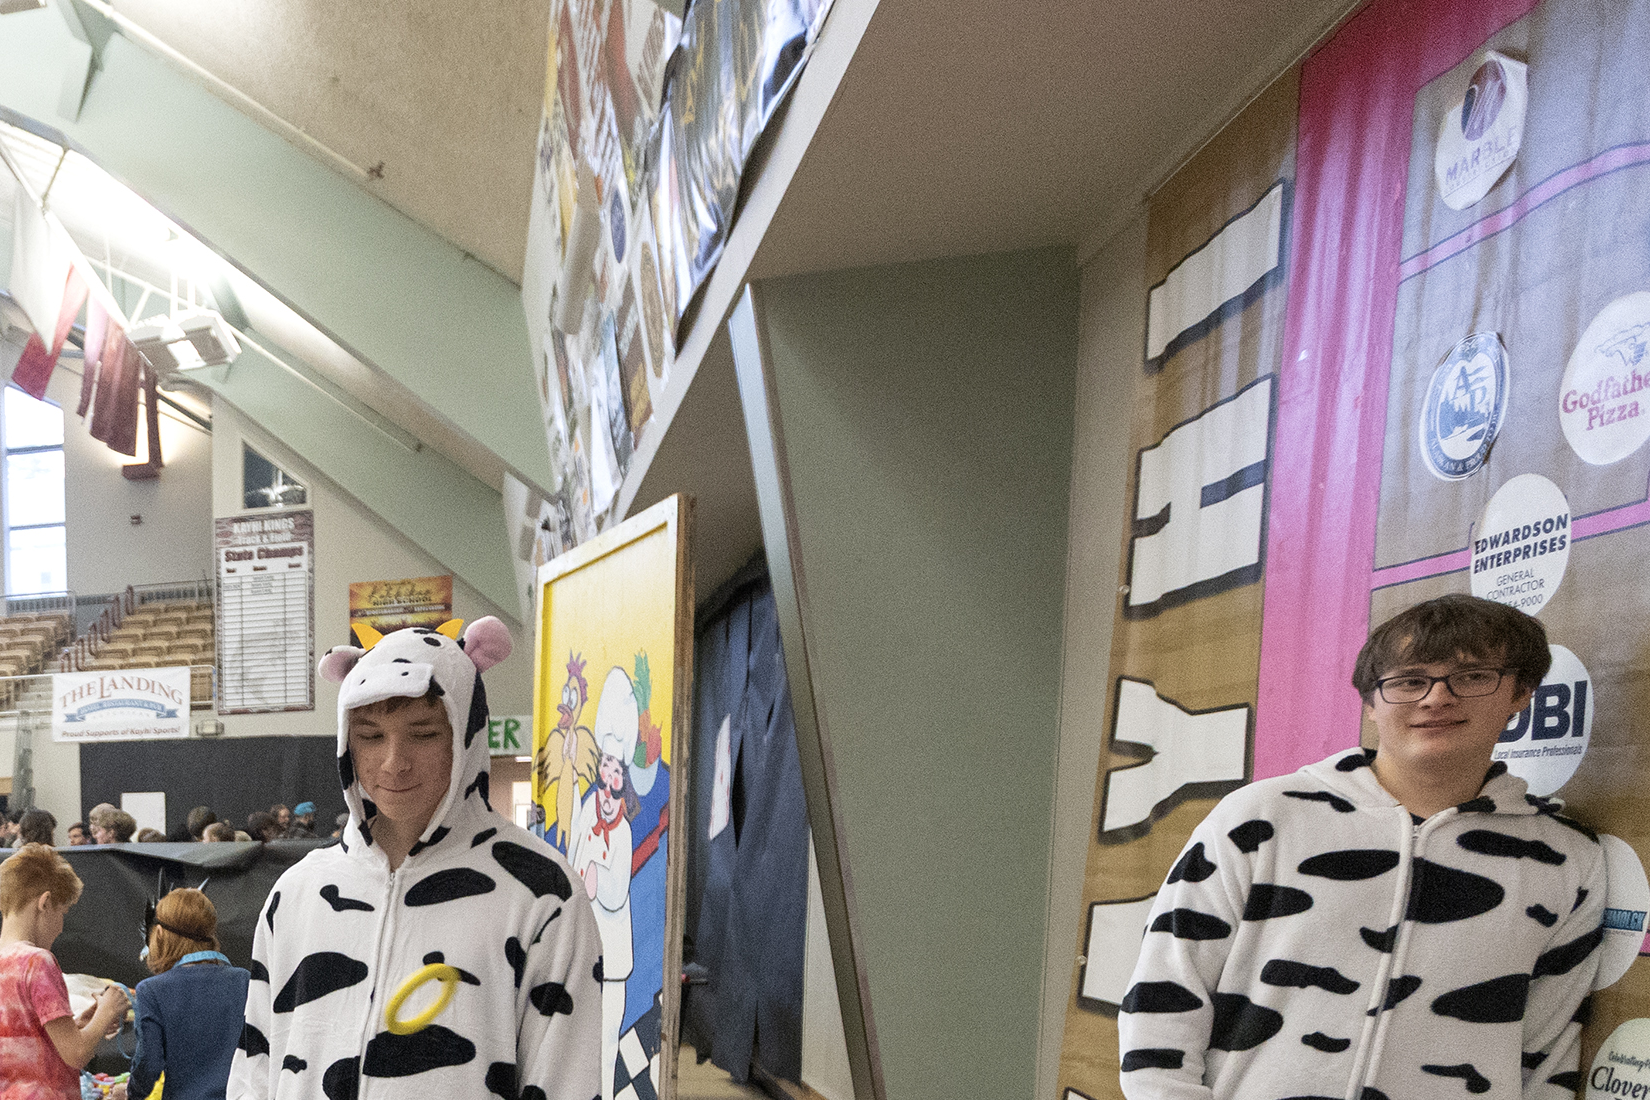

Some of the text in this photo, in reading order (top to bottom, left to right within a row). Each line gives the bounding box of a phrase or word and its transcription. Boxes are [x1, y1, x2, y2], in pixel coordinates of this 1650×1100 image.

[1586, 400, 1640, 431] Pizza
[264, 517, 295, 533] KINGS
[1474, 513, 1569, 556] EDWARDSON
[1473, 534, 1568, 575] ENTERPRISES
[1496, 568, 1535, 587] GENERAL
[1486, 578, 1546, 601] CONTRACTOR
[1504, 593, 1544, 608] 4-9000
[59, 675, 184, 708] THE LANDING
[61, 729, 85, 739] Proud
[85, 727, 120, 739] Supports
[120, 727, 130, 736] of
[130, 726, 152, 738] Kayhi
[1509, 746, 1541, 759] Insurance
[1541, 743, 1583, 758] Professionals
